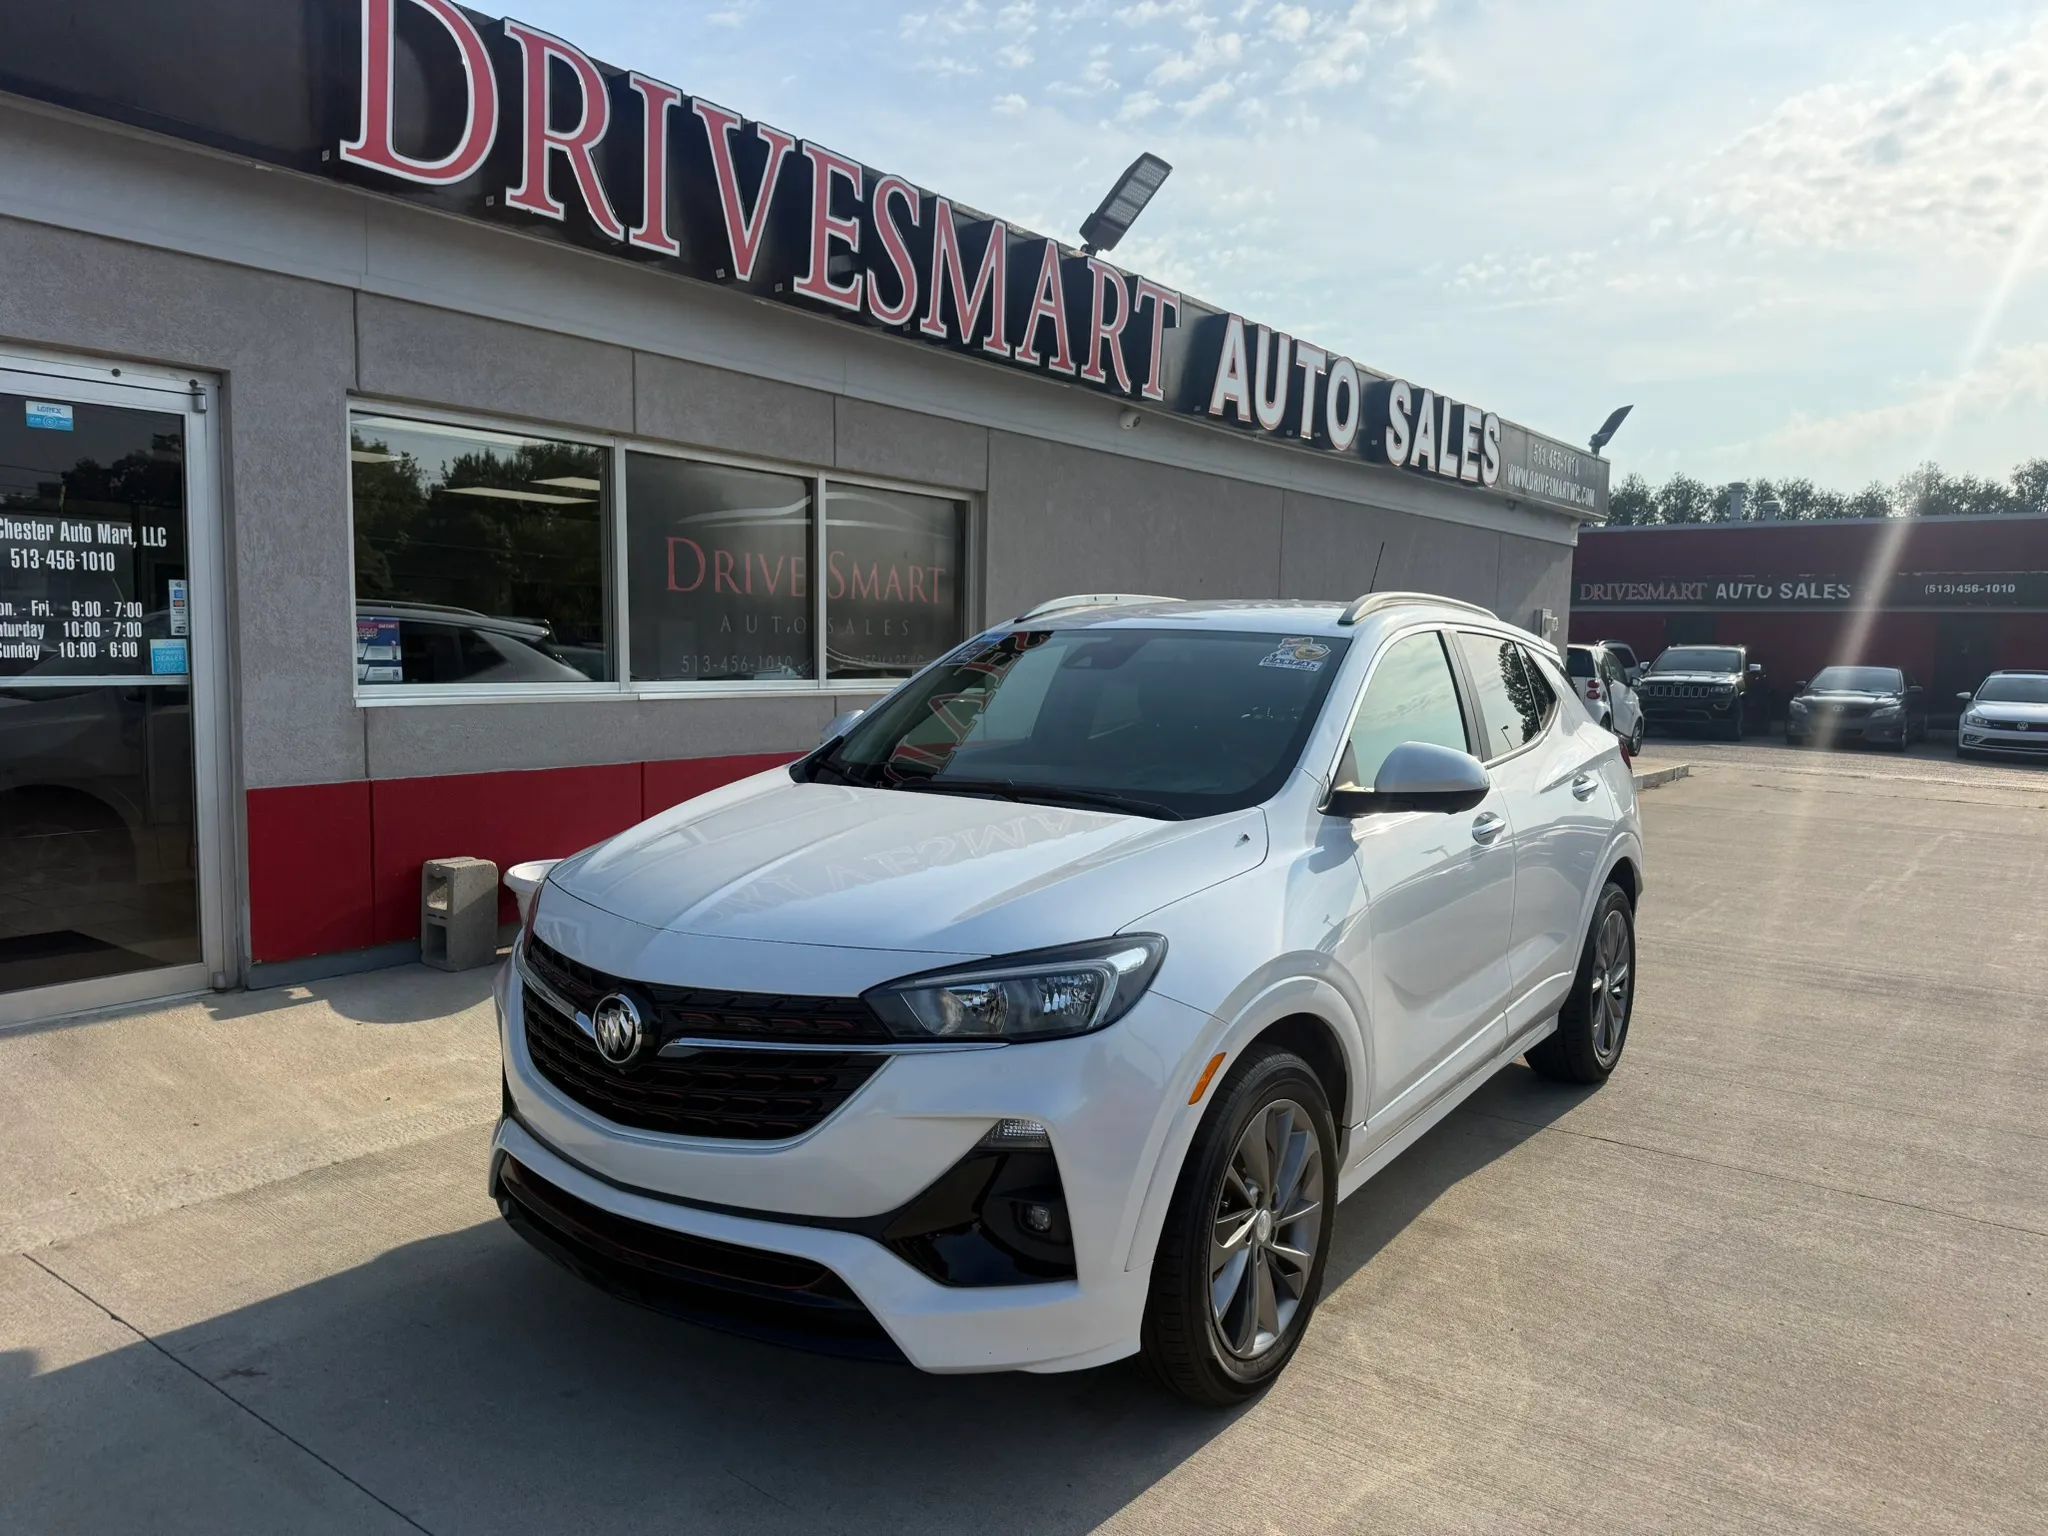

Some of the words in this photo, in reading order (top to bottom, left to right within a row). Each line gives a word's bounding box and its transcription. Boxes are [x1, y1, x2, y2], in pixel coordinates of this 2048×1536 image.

[339, 0, 1182, 402] DRIVESMART
[1208, 313, 1361, 451] AUTO
[1385, 379, 1502, 488] SALES
[60, 521, 92, 543] Auto
[98, 523, 137, 548] Mart,
[142, 526, 167, 547] LLC
[11, 547, 116, 572] 513-456-1010
[665, 536, 806, 598] DRIVE
[827, 550, 946, 604] SMART
[1580, 582, 1708, 600] DRIVESMART
[1715, 582, 1772, 600] AUTO
[1779, 582, 1851, 600] SALES
[31, 600, 54, 617] Fri.
[72, 600, 101, 617] 9:00
[113, 601, 143, 618] 7:00
[63, 621, 101, 638] 10:00
[113, 621, 143, 638] 7:00
[720, 615, 807, 634] AUTO
[826, 616, 911, 636] SALES
[59, 641, 97, 658] 10:00
[110, 641, 139, 658] 6:00
